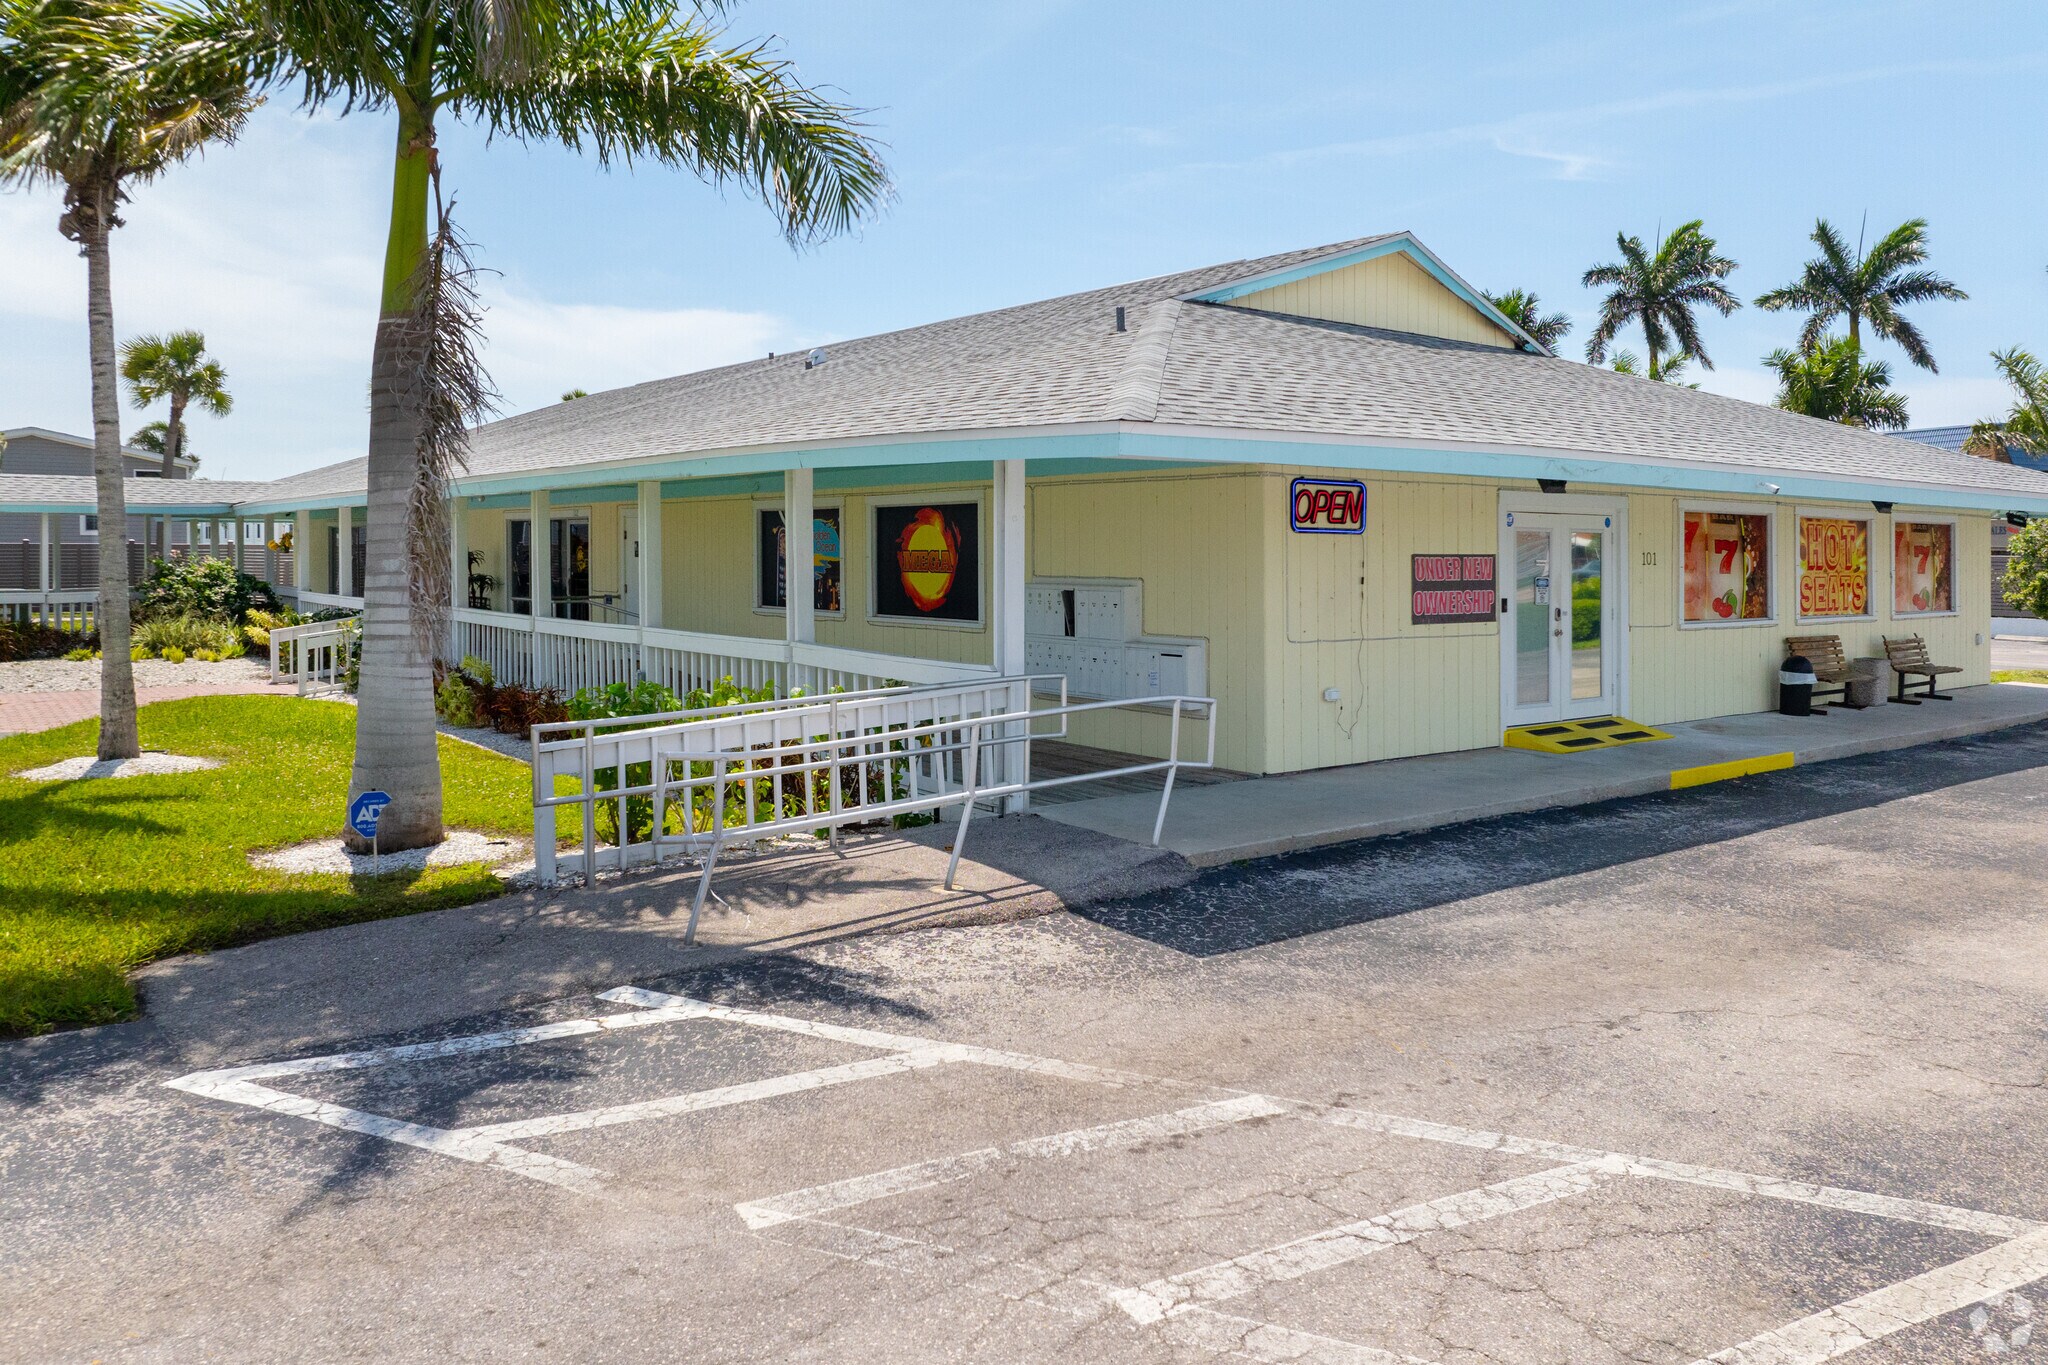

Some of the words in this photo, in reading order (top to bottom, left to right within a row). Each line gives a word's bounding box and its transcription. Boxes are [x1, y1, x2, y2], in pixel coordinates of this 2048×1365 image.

[1296, 489, 1363, 524] OPEN
[901, 549, 954, 573] MEGA
[1642, 552, 1657, 566] 101
[1715, 539, 1738, 574] 7
[1805, 523, 1856, 571] HOT
[1914, 545, 1930, 574] 7
[1415, 556, 1461, 581] UNDER
[1463, 556, 1494, 580] NEW
[1413, 590, 1495, 616] OWNERSHIP
[1800, 575, 1865, 613] SEATS
